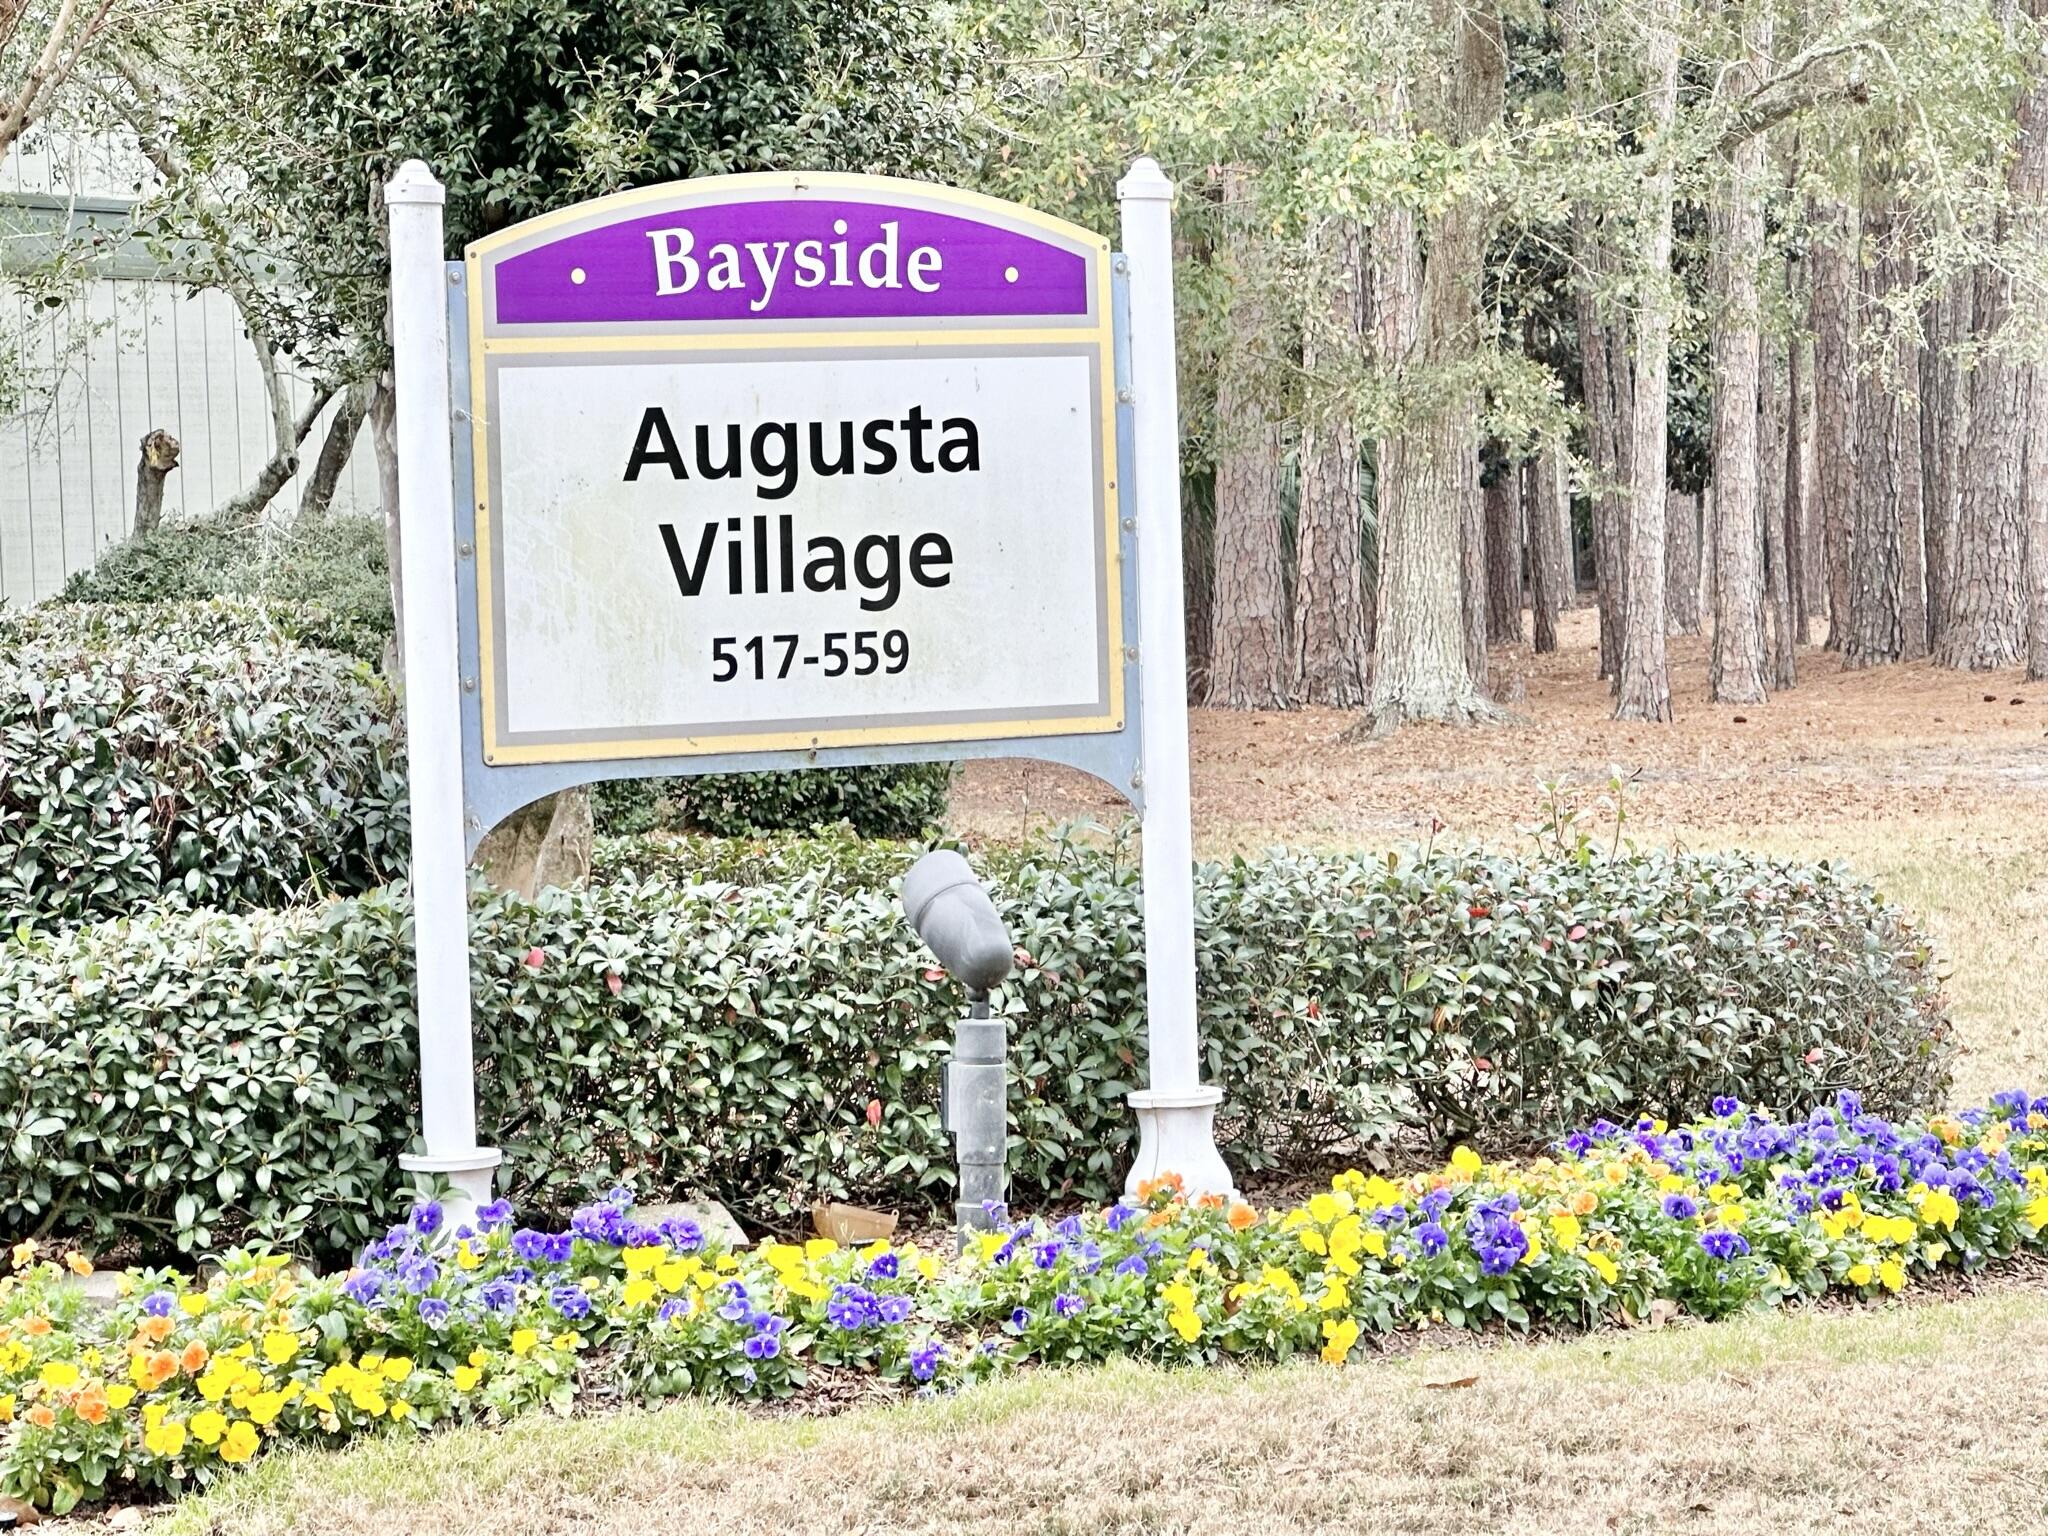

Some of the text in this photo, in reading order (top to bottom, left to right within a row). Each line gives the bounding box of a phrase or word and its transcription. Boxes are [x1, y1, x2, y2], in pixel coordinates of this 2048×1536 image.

[646, 219, 943, 312] Bayside
[622, 404, 981, 500] Augusta
[658, 514, 953, 612] Village
[712, 629, 910, 684] 517-559
